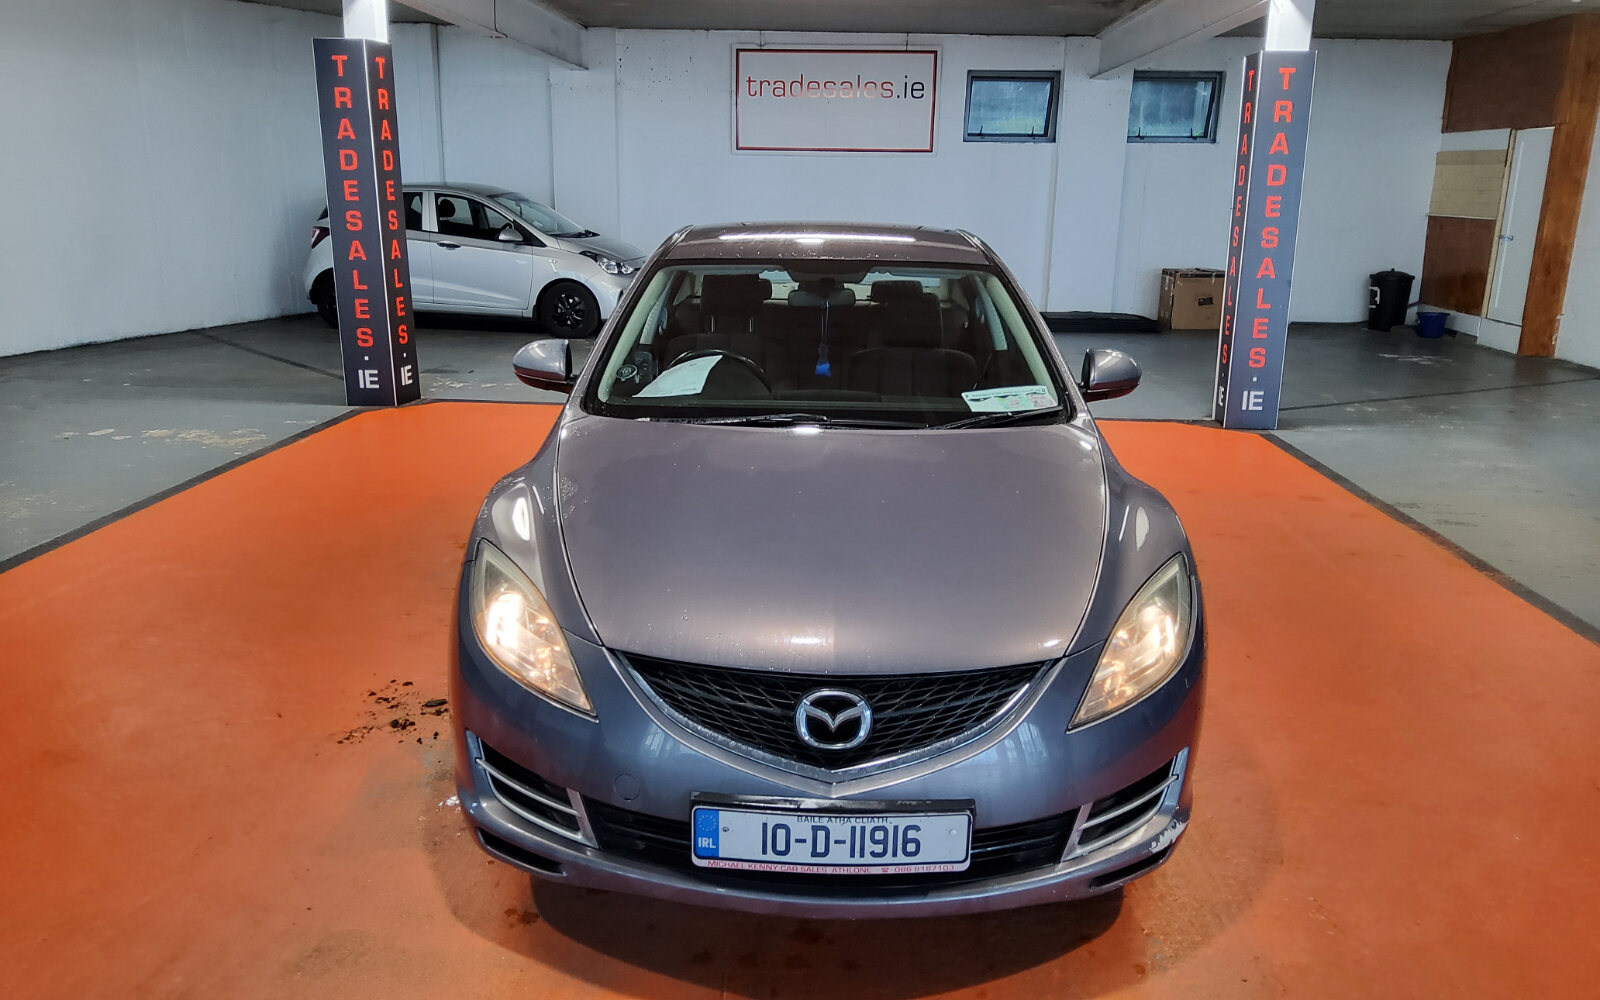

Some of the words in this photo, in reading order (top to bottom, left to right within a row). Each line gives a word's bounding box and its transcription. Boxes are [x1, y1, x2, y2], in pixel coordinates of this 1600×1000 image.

[746, 73, 925, 99] tradesales.ie
[698, 837, 716, 849] IRL
[761, 822, 921, 858] 10-D-11916
[707, 860, 745, 869] MICHAEL
